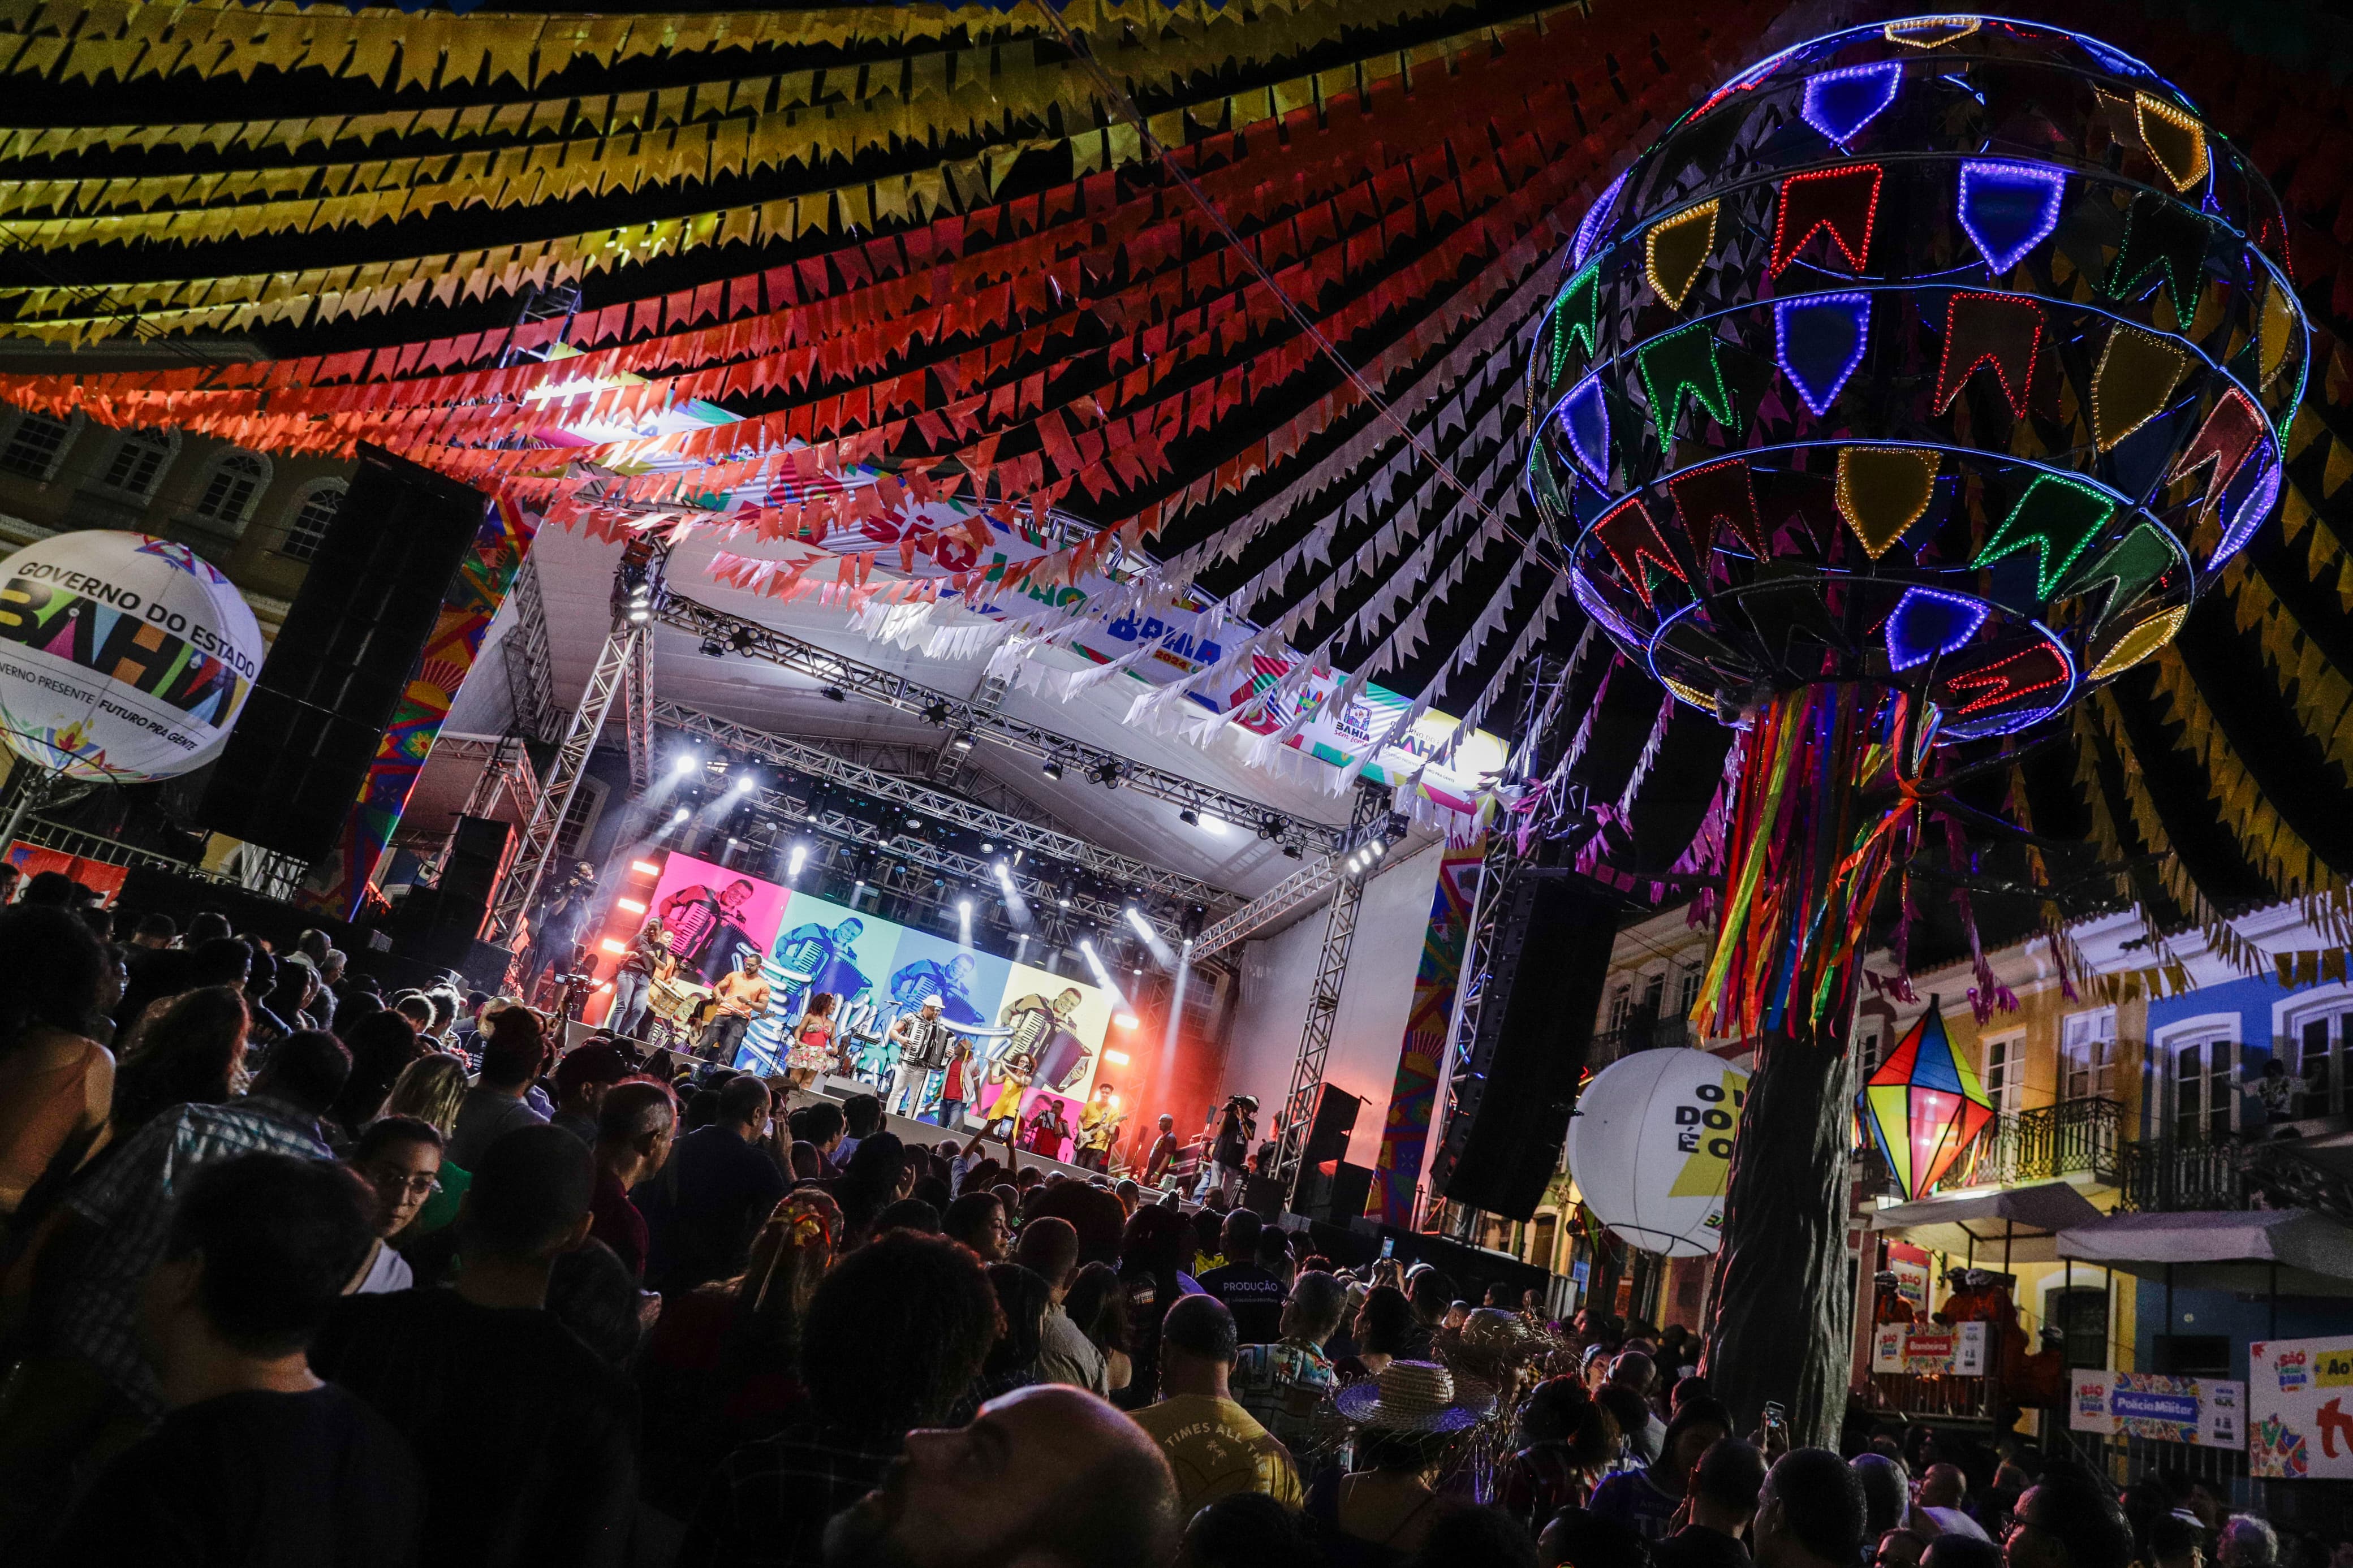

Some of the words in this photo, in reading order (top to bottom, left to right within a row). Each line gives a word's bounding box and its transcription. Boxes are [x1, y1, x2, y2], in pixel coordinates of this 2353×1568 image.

[18, 562, 141, 610] GOVERNO
[145, 603, 187, 632] DO
[190, 625, 255, 679] ESTADO
[1107, 609, 1222, 666] BAHIA
[0, 577, 237, 729] BAHIA
[1154, 650, 1187, 669] 2024
[0, 662, 36, 683] VERNO
[38, 676, 95, 705] PRESENTE
[98, 699, 147, 727] FUTURO
[146, 722, 168, 737] PRA
[167, 732, 198, 751] GENTE
[1334, 729, 1349, 740] sem
[1350, 735, 1369, 747] fome
[1336, 722, 1369, 742] BAHIA
[1223, 1280, 1278, 1293] PRODUÇÃO
[2328, 1358, 2350, 1375] Ao
[1165, 1422, 1210, 1447] TIMES
[1216, 1423, 1242, 1443] ALL
[1248, 1442, 1268, 1473] THE
